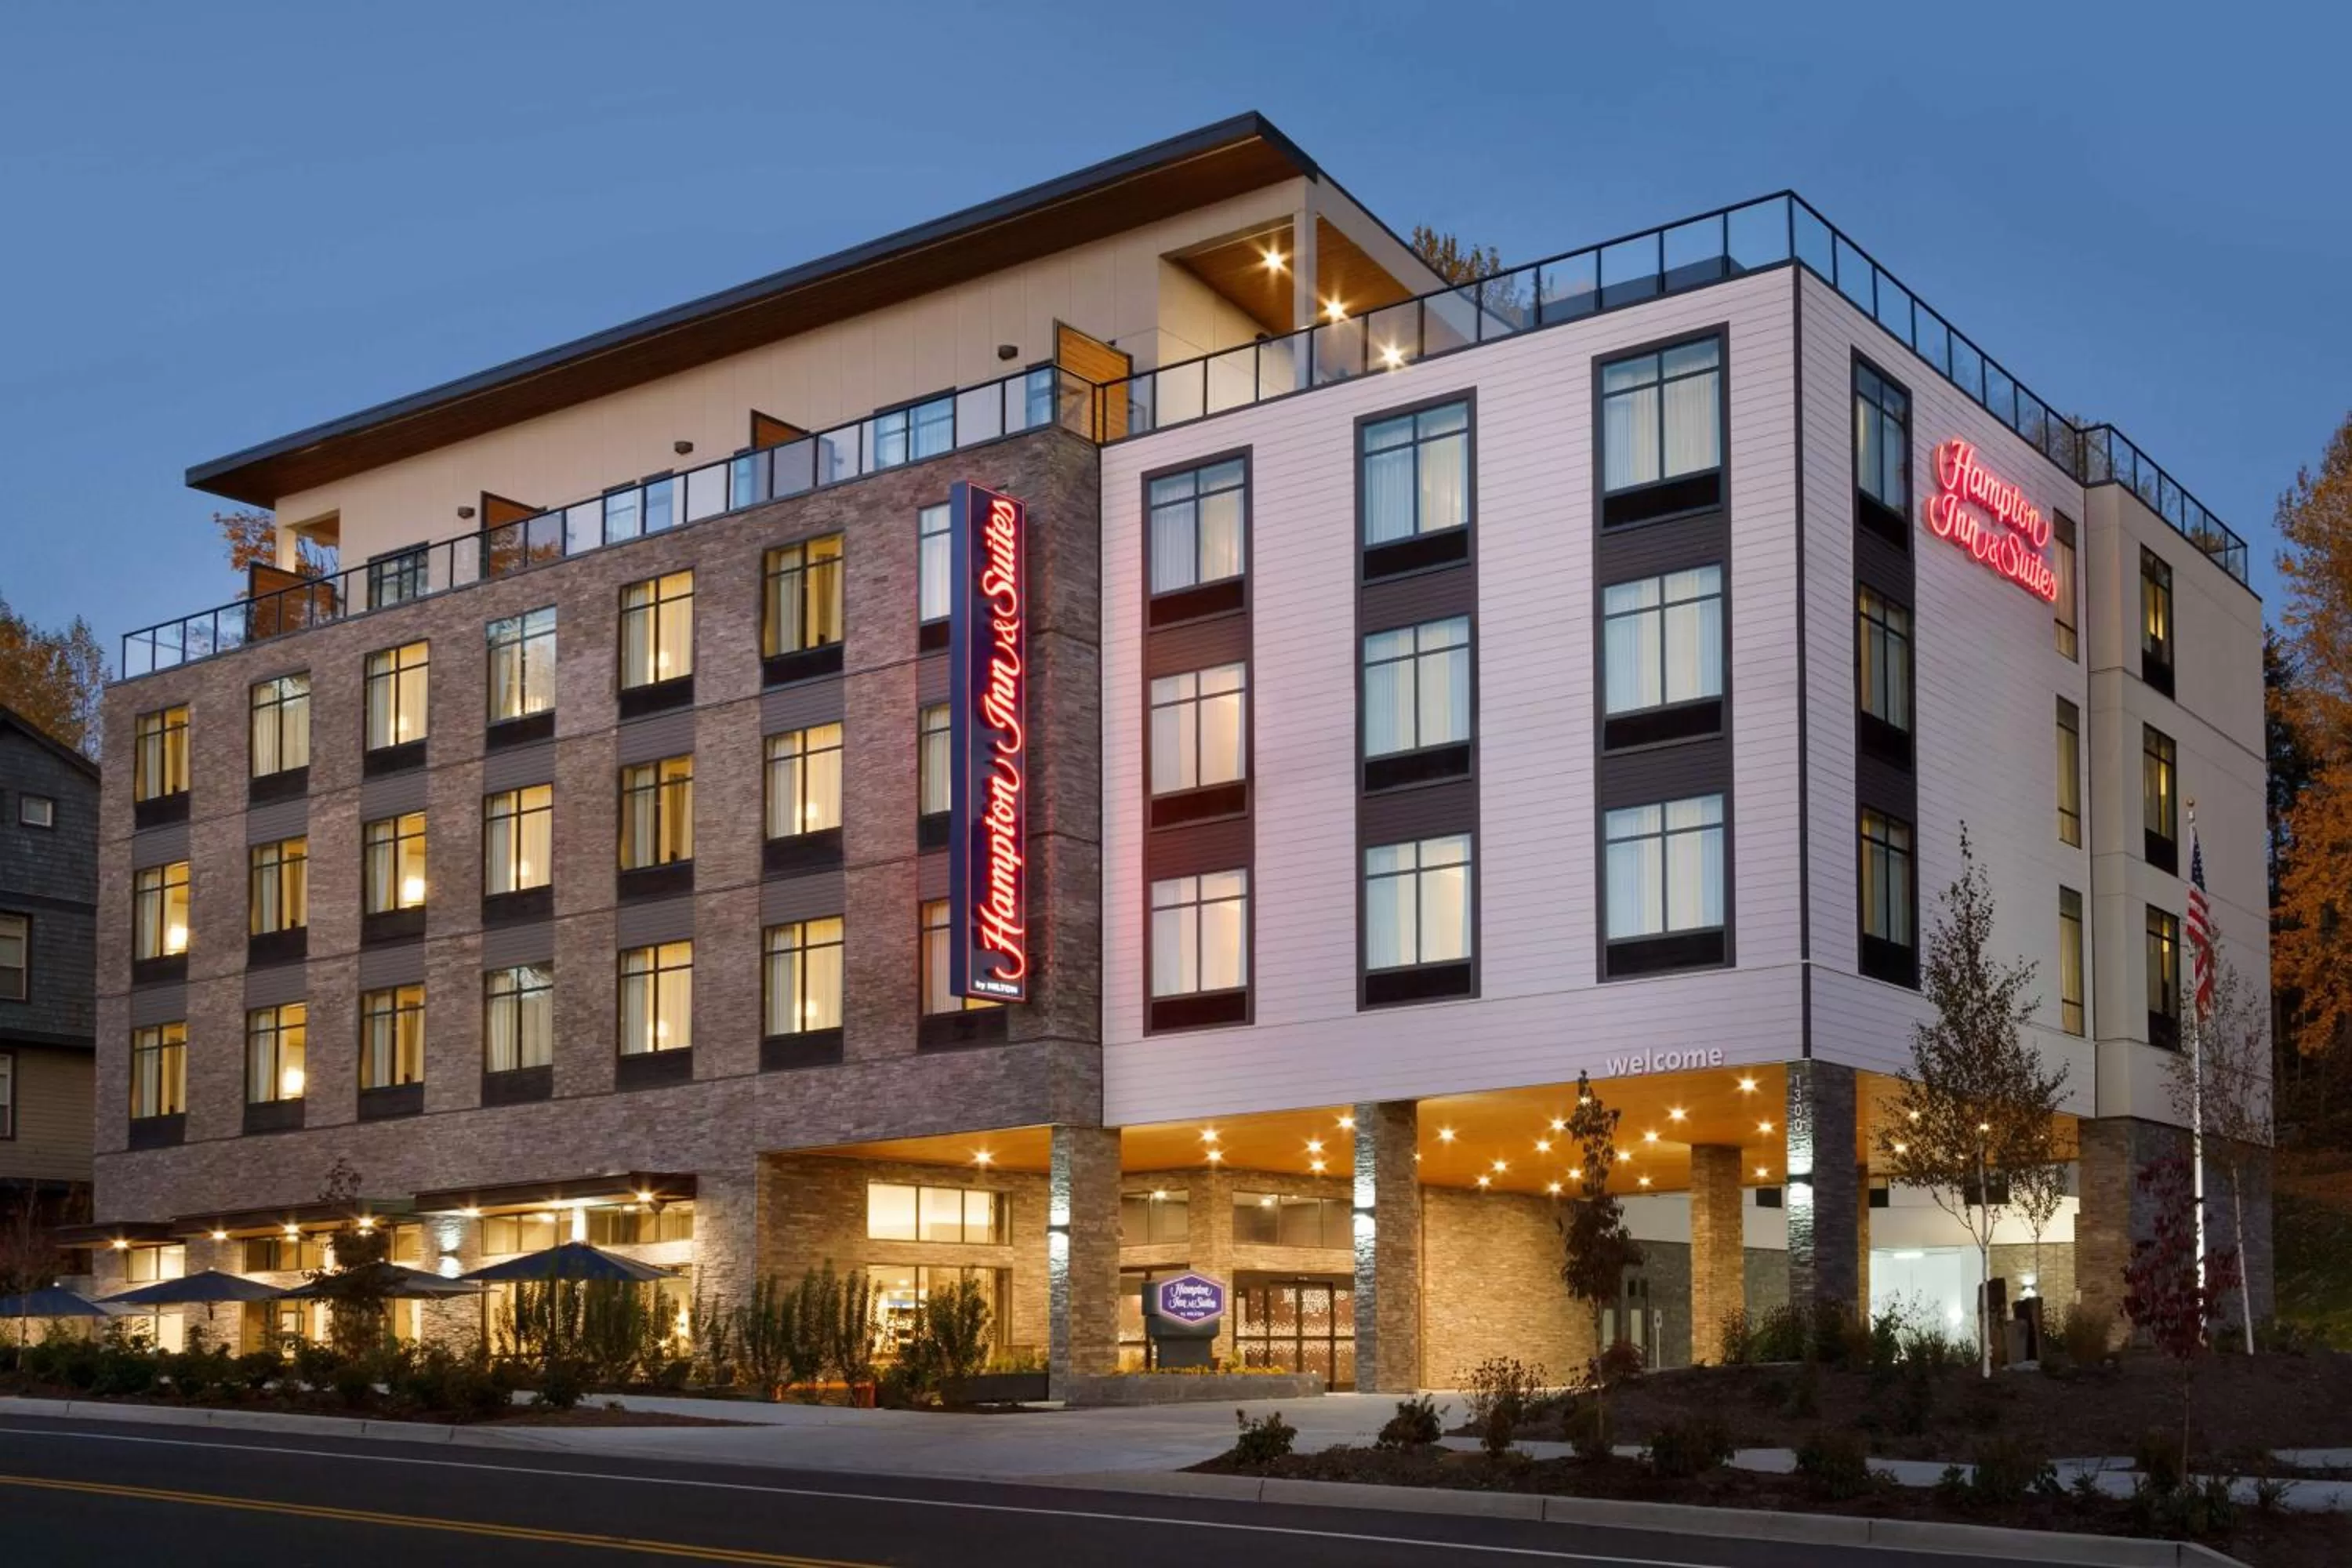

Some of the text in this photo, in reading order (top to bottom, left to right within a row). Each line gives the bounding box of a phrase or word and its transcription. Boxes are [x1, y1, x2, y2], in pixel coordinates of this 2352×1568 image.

[1939, 439, 2049, 547] Hampton
[1929, 493, 2057, 602] Inn & Suites
[980, 499, 1025, 979] Hampton Inn & Suites
[1606, 1047, 1722, 1076] welcome
[1794, 1073, 1802, 1131] 1300
